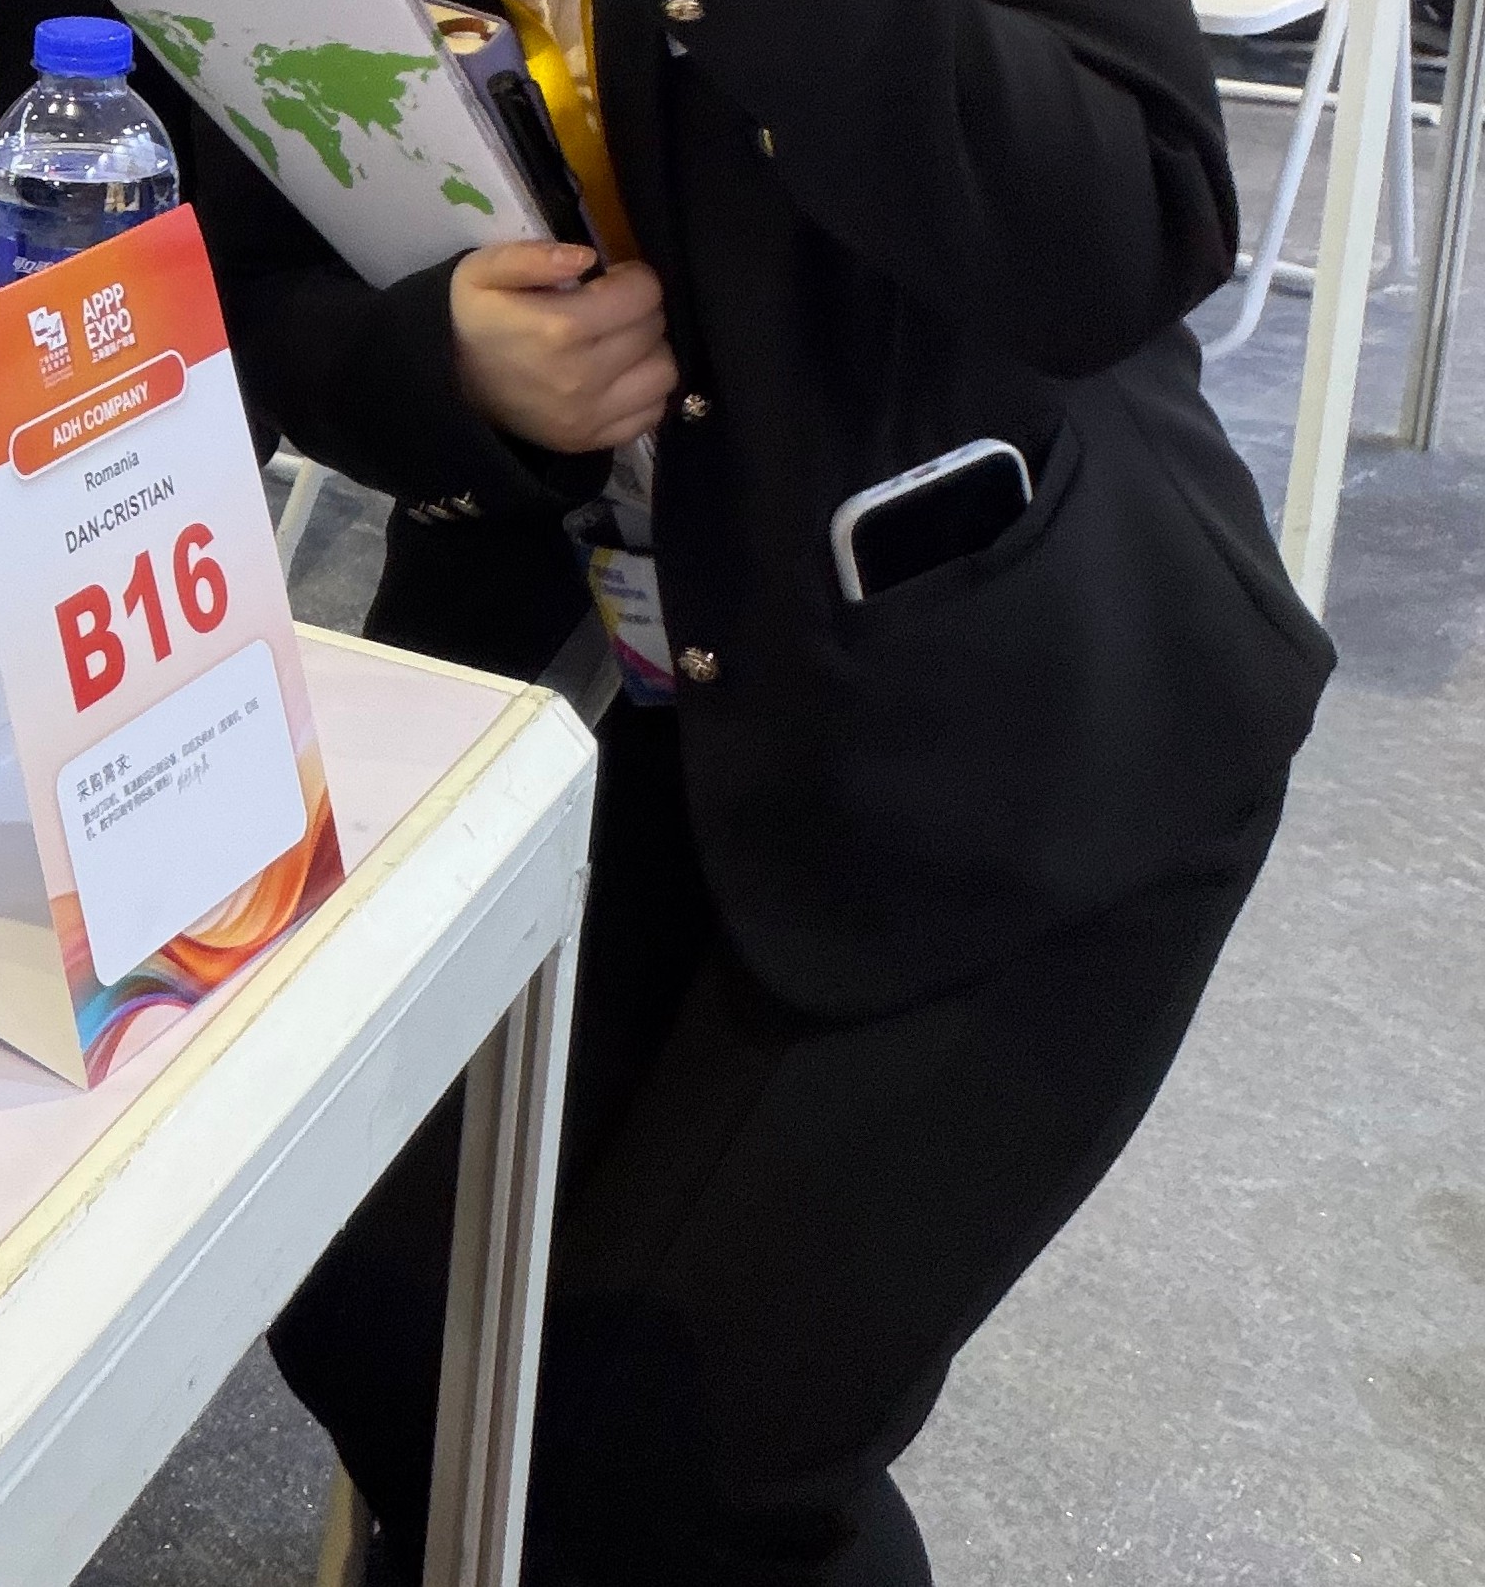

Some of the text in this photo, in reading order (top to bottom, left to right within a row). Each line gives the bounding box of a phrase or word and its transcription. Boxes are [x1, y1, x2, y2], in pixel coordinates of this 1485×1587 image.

[82, 282, 125, 325] APPP
[85, 307, 132, 350] EXPO
[52, 380, 149, 450] ADH COMPANY
[84, 450, 141, 492] Romania
[65, 475, 175, 555] DAN-CRISTIAN
[54, 521, 229, 713] B16
